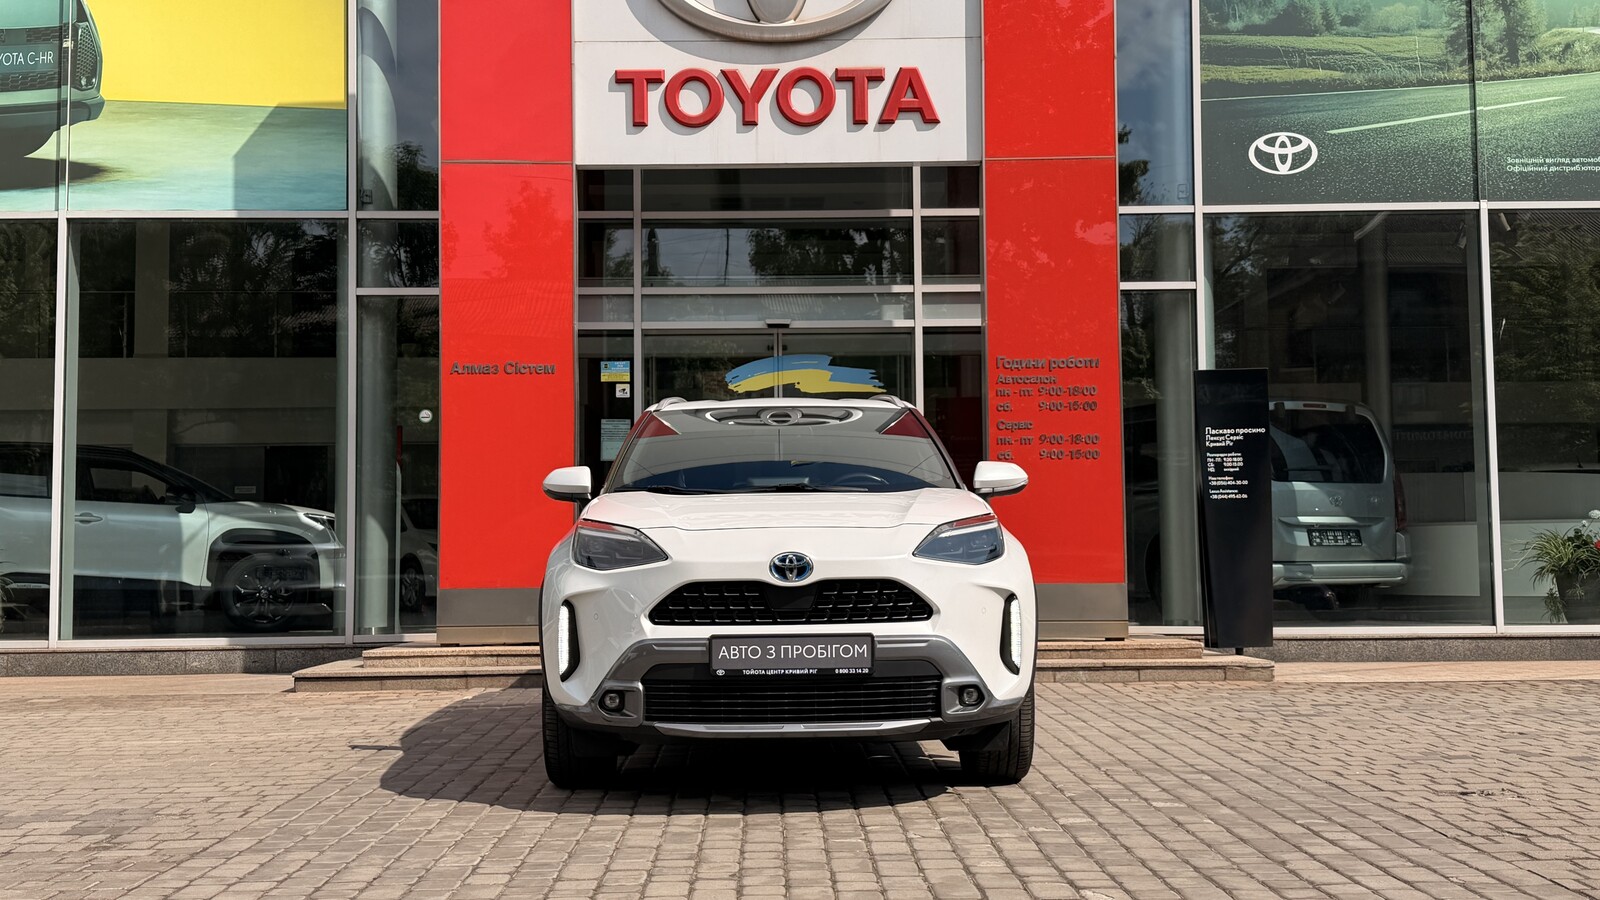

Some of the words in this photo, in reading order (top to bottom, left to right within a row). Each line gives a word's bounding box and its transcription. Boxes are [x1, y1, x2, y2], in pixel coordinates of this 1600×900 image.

[27, 51, 54, 65] C-HR
[615, 67, 940, 127] TOYOTA
[1506, 156, 1545, 164] Зовнішній
[450, 361, 499, 375] Алмаз
[504, 361, 556, 375] Сістем
[996, 356, 1047, 371] Години
[1049, 356, 1100, 372] роботи
[996, 374, 1057, 384] Автосалон
[997, 420, 1034, 432] Сервіс
[1205, 427, 1235, 435] Ласкаво
[718, 645, 762, 660] АВТО
[766, 645, 776, 659] З
[781, 643, 868, 659] ПРОБІГОМ
